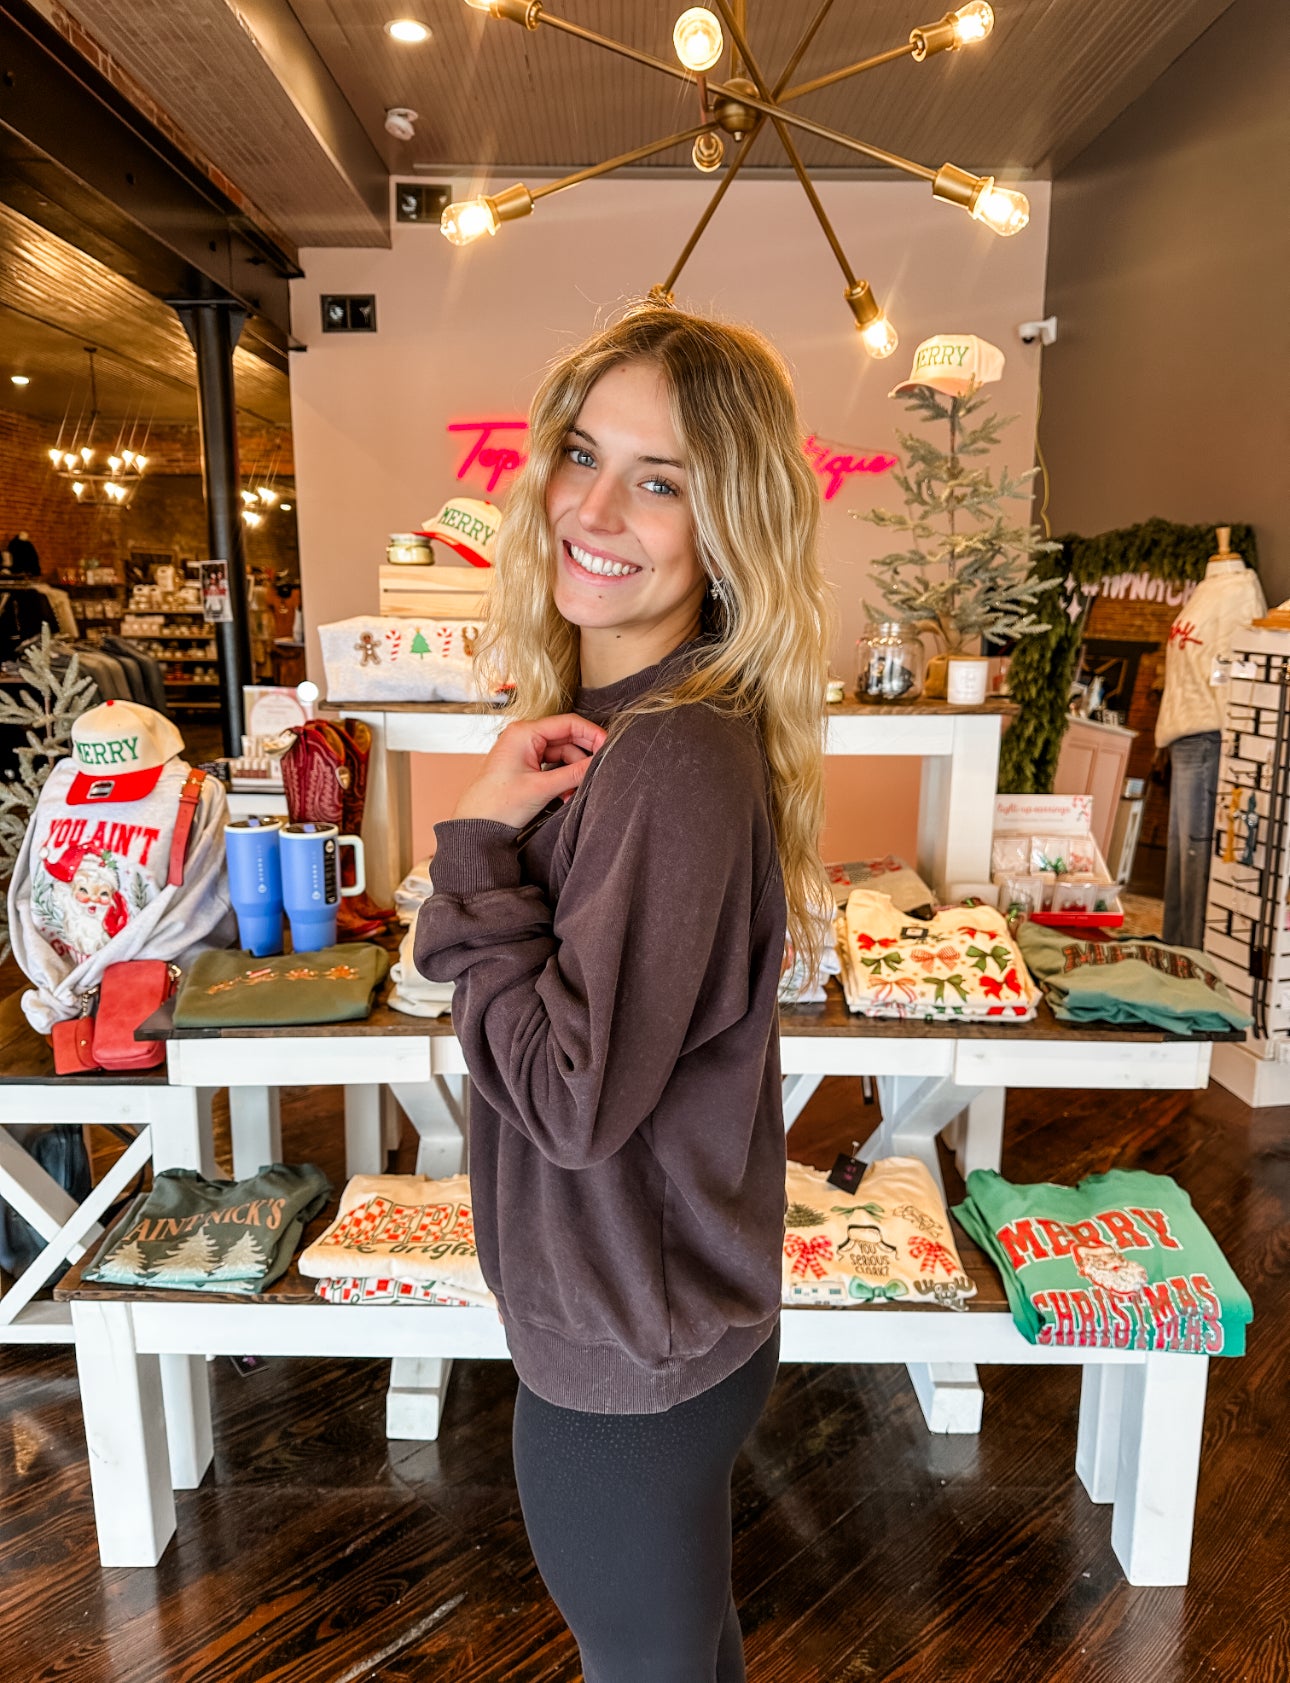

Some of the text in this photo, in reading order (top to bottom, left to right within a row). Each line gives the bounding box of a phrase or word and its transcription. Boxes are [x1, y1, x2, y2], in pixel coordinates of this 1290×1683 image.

[916, 345, 969, 372] ERRY
[448, 422, 528, 492] Top
[438, 507, 496, 546] MERRY
[43, 819, 160, 866] YOU AIN'T
[203, 1198, 286, 1230] NICK'S
[858, 1242, 877, 1255] YOU
[996, 1207, 1183, 1272] MERRY
[850, 1254, 890, 1268] SERIOUS
[855, 1266, 889, 1277] CLARK?
[1031, 1274, 1223, 1344] CHRISTMAS
